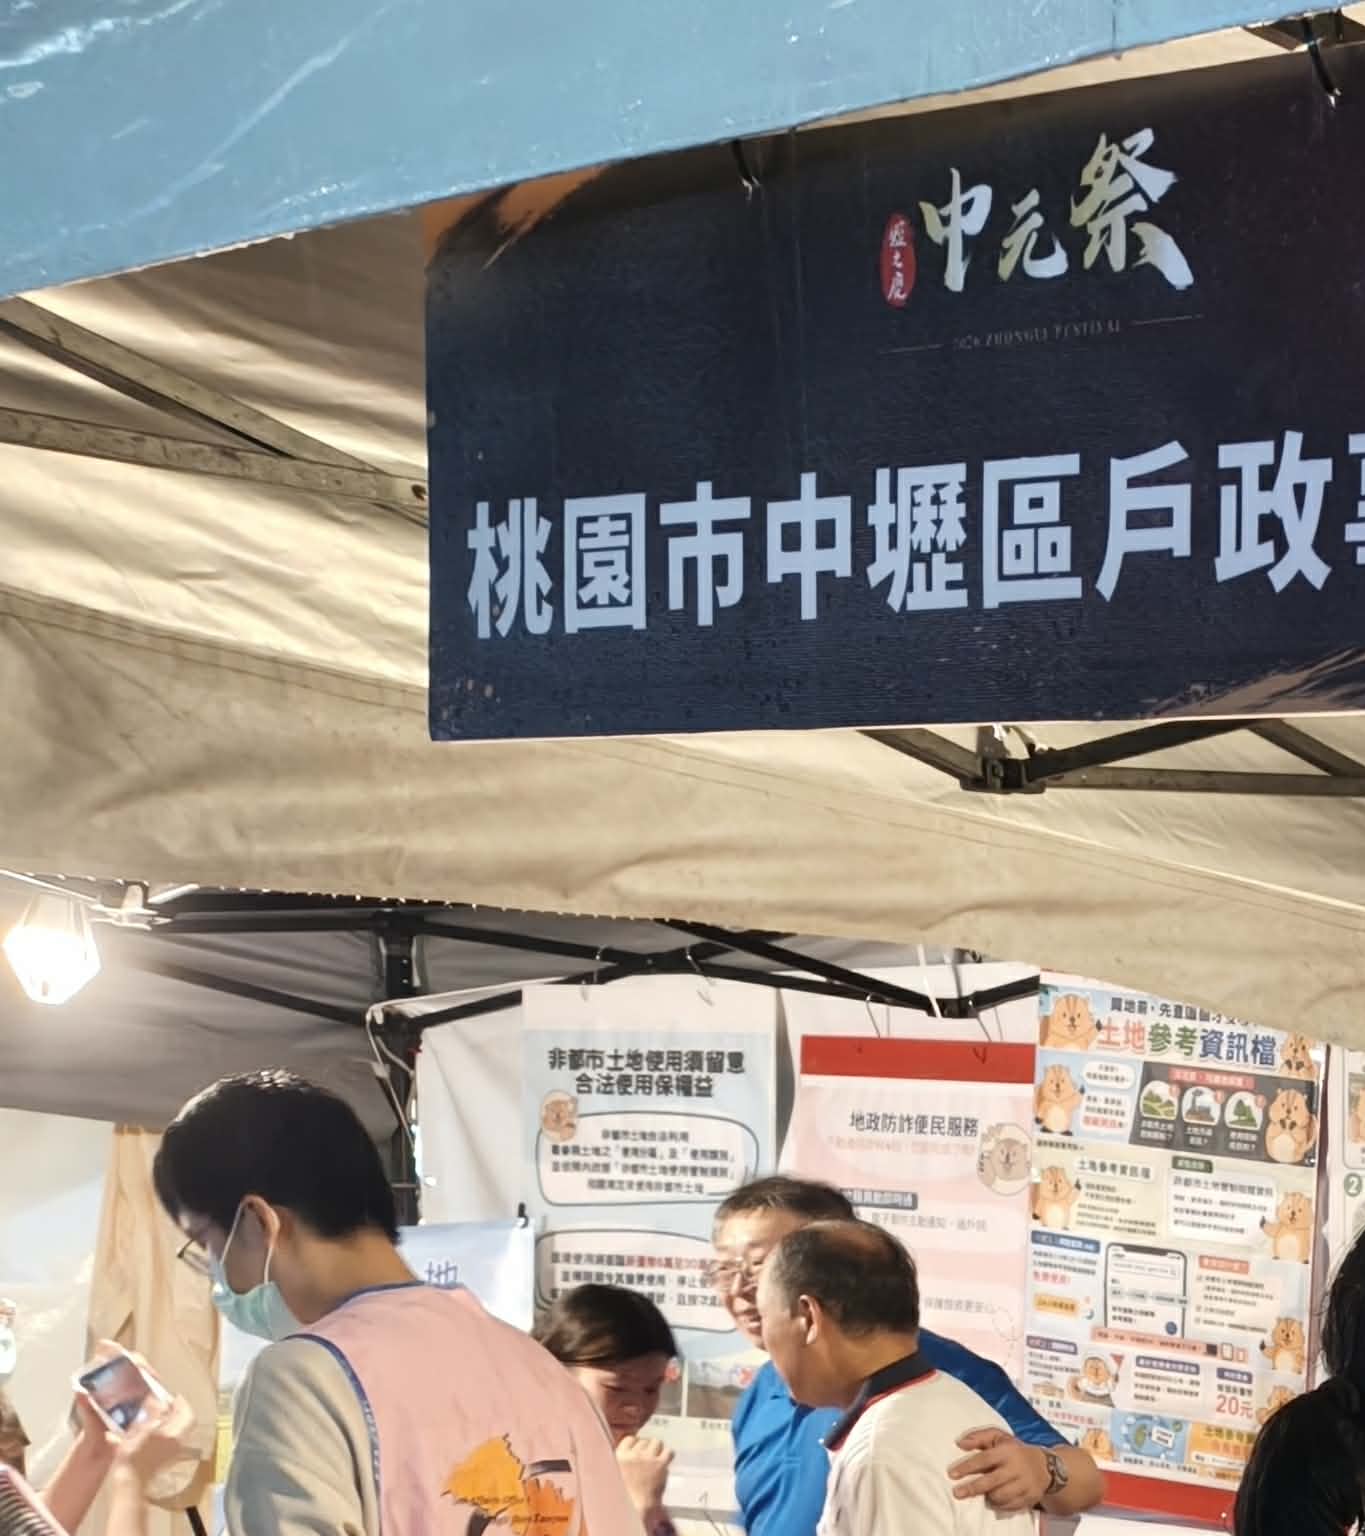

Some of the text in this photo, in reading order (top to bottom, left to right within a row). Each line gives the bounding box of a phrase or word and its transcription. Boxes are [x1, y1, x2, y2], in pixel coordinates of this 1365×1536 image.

[919, 128, 1194, 292] 中元祭
[1101, 1016, 1276, 1067] 土地參考資訊檔
[850, 1111, 979, 1137] 地政防詐便民服務
[1216, 1393, 1253, 1419] 20元
